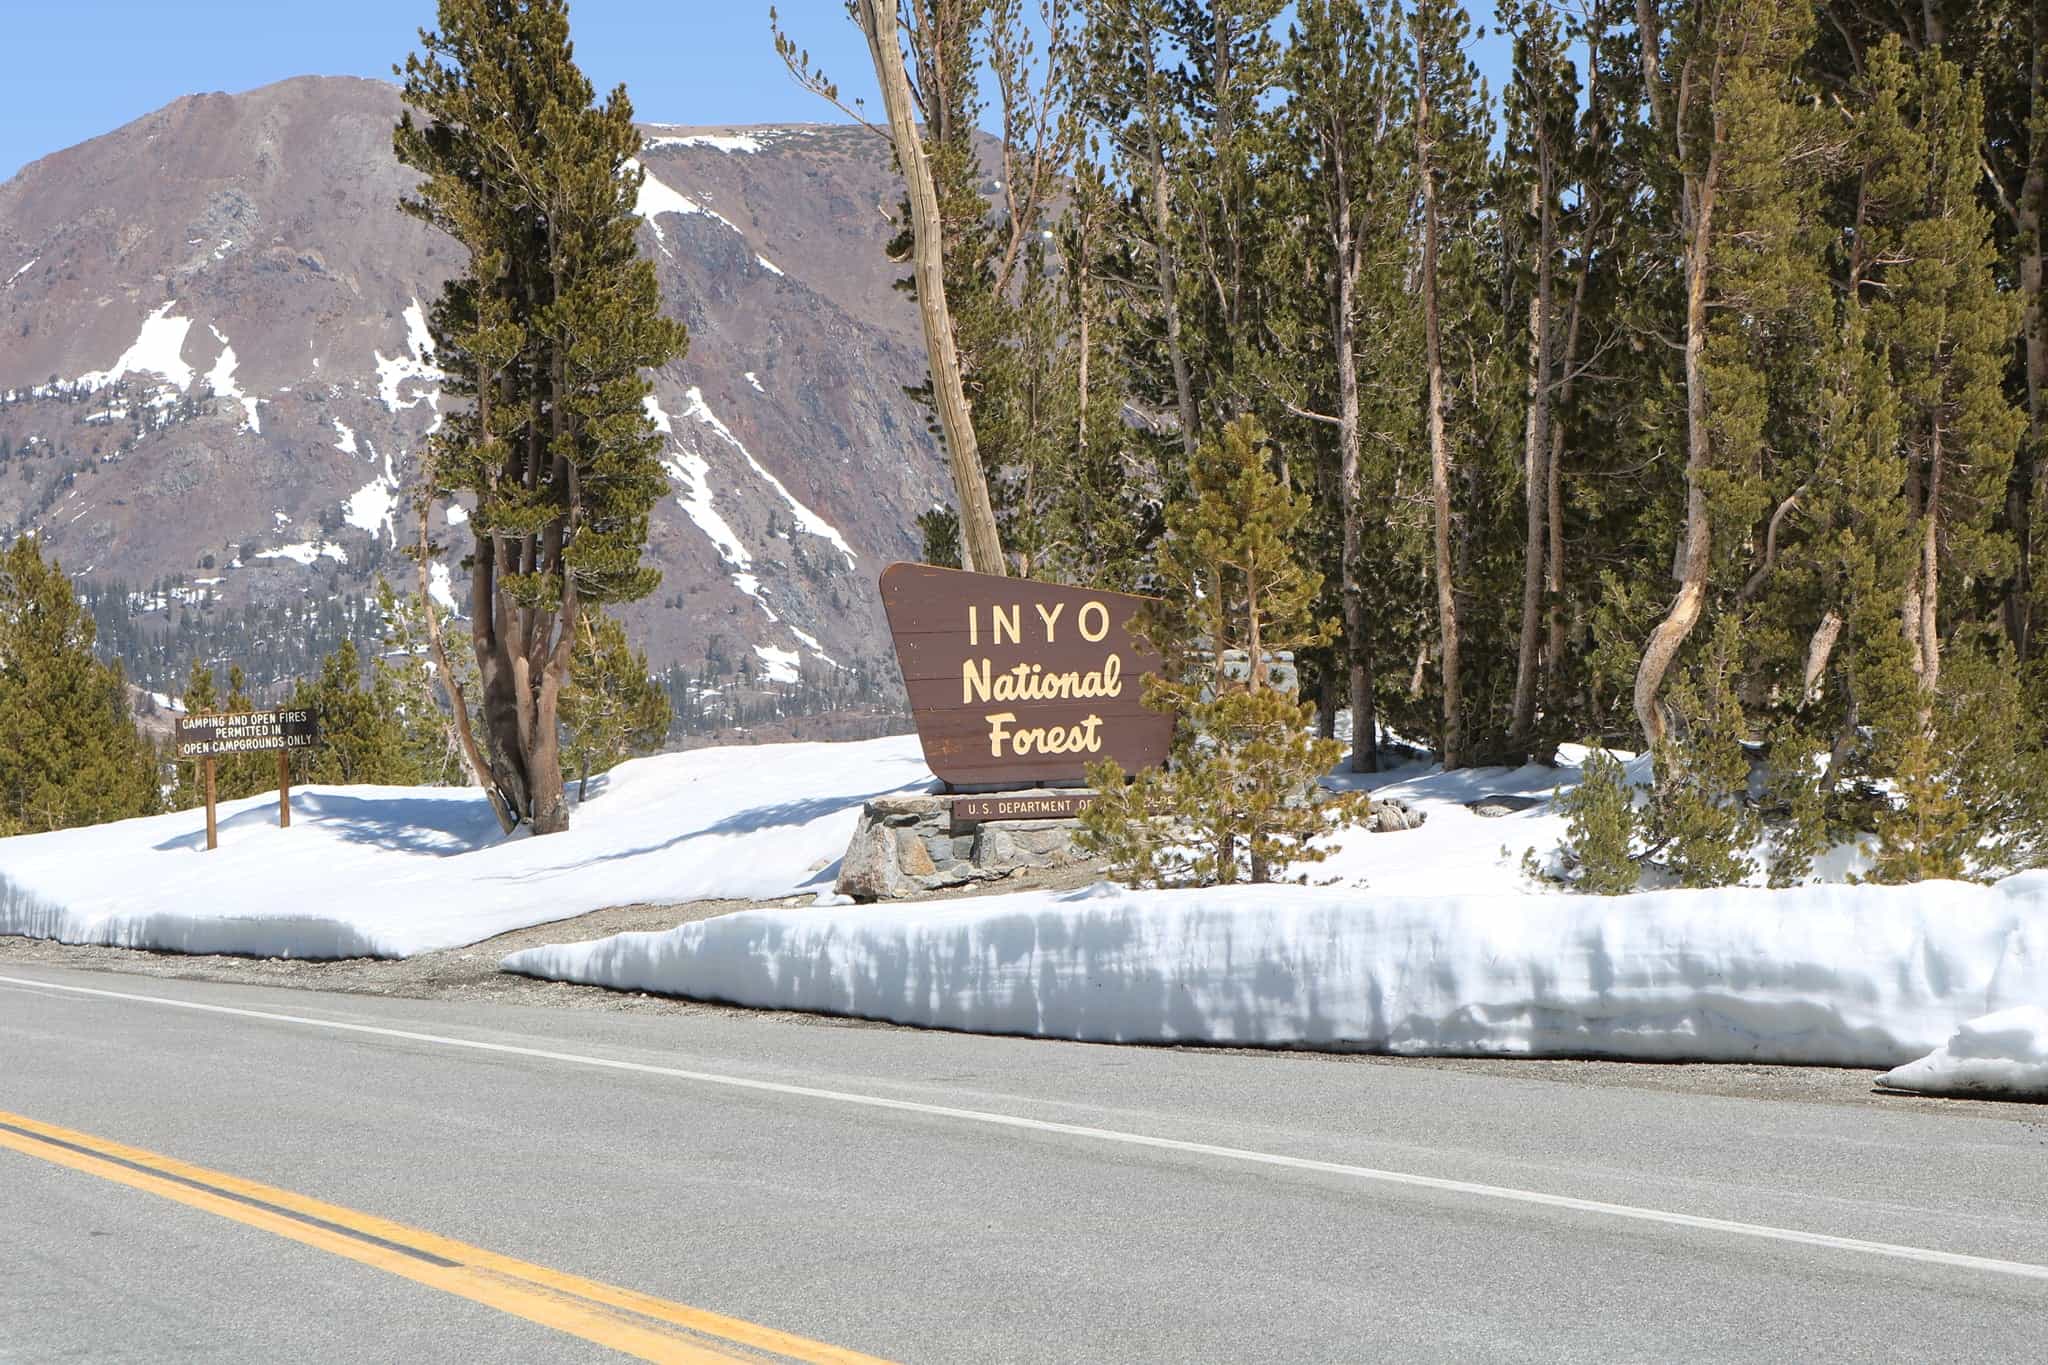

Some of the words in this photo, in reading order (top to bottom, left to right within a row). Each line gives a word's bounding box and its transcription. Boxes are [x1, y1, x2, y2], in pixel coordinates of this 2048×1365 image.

[968, 600, 1110, 646] INYO
[962, 653, 1122, 704] National
[182, 716, 225, 730] CAMPING
[228, 715, 248, 726] AND
[250, 713, 276, 726] OPEN
[279, 711, 307, 723] FIRES
[215, 725, 269, 739] PERMITTED
[271, 724, 282, 735] IN
[985, 712, 1104, 757] Forest
[183, 743, 209, 755] OPEN
[212, 736, 285, 753] CAMPGROUNDS
[287, 734, 312, 746] ONLY
[998, 799, 1072, 814] DEPARTMENT
